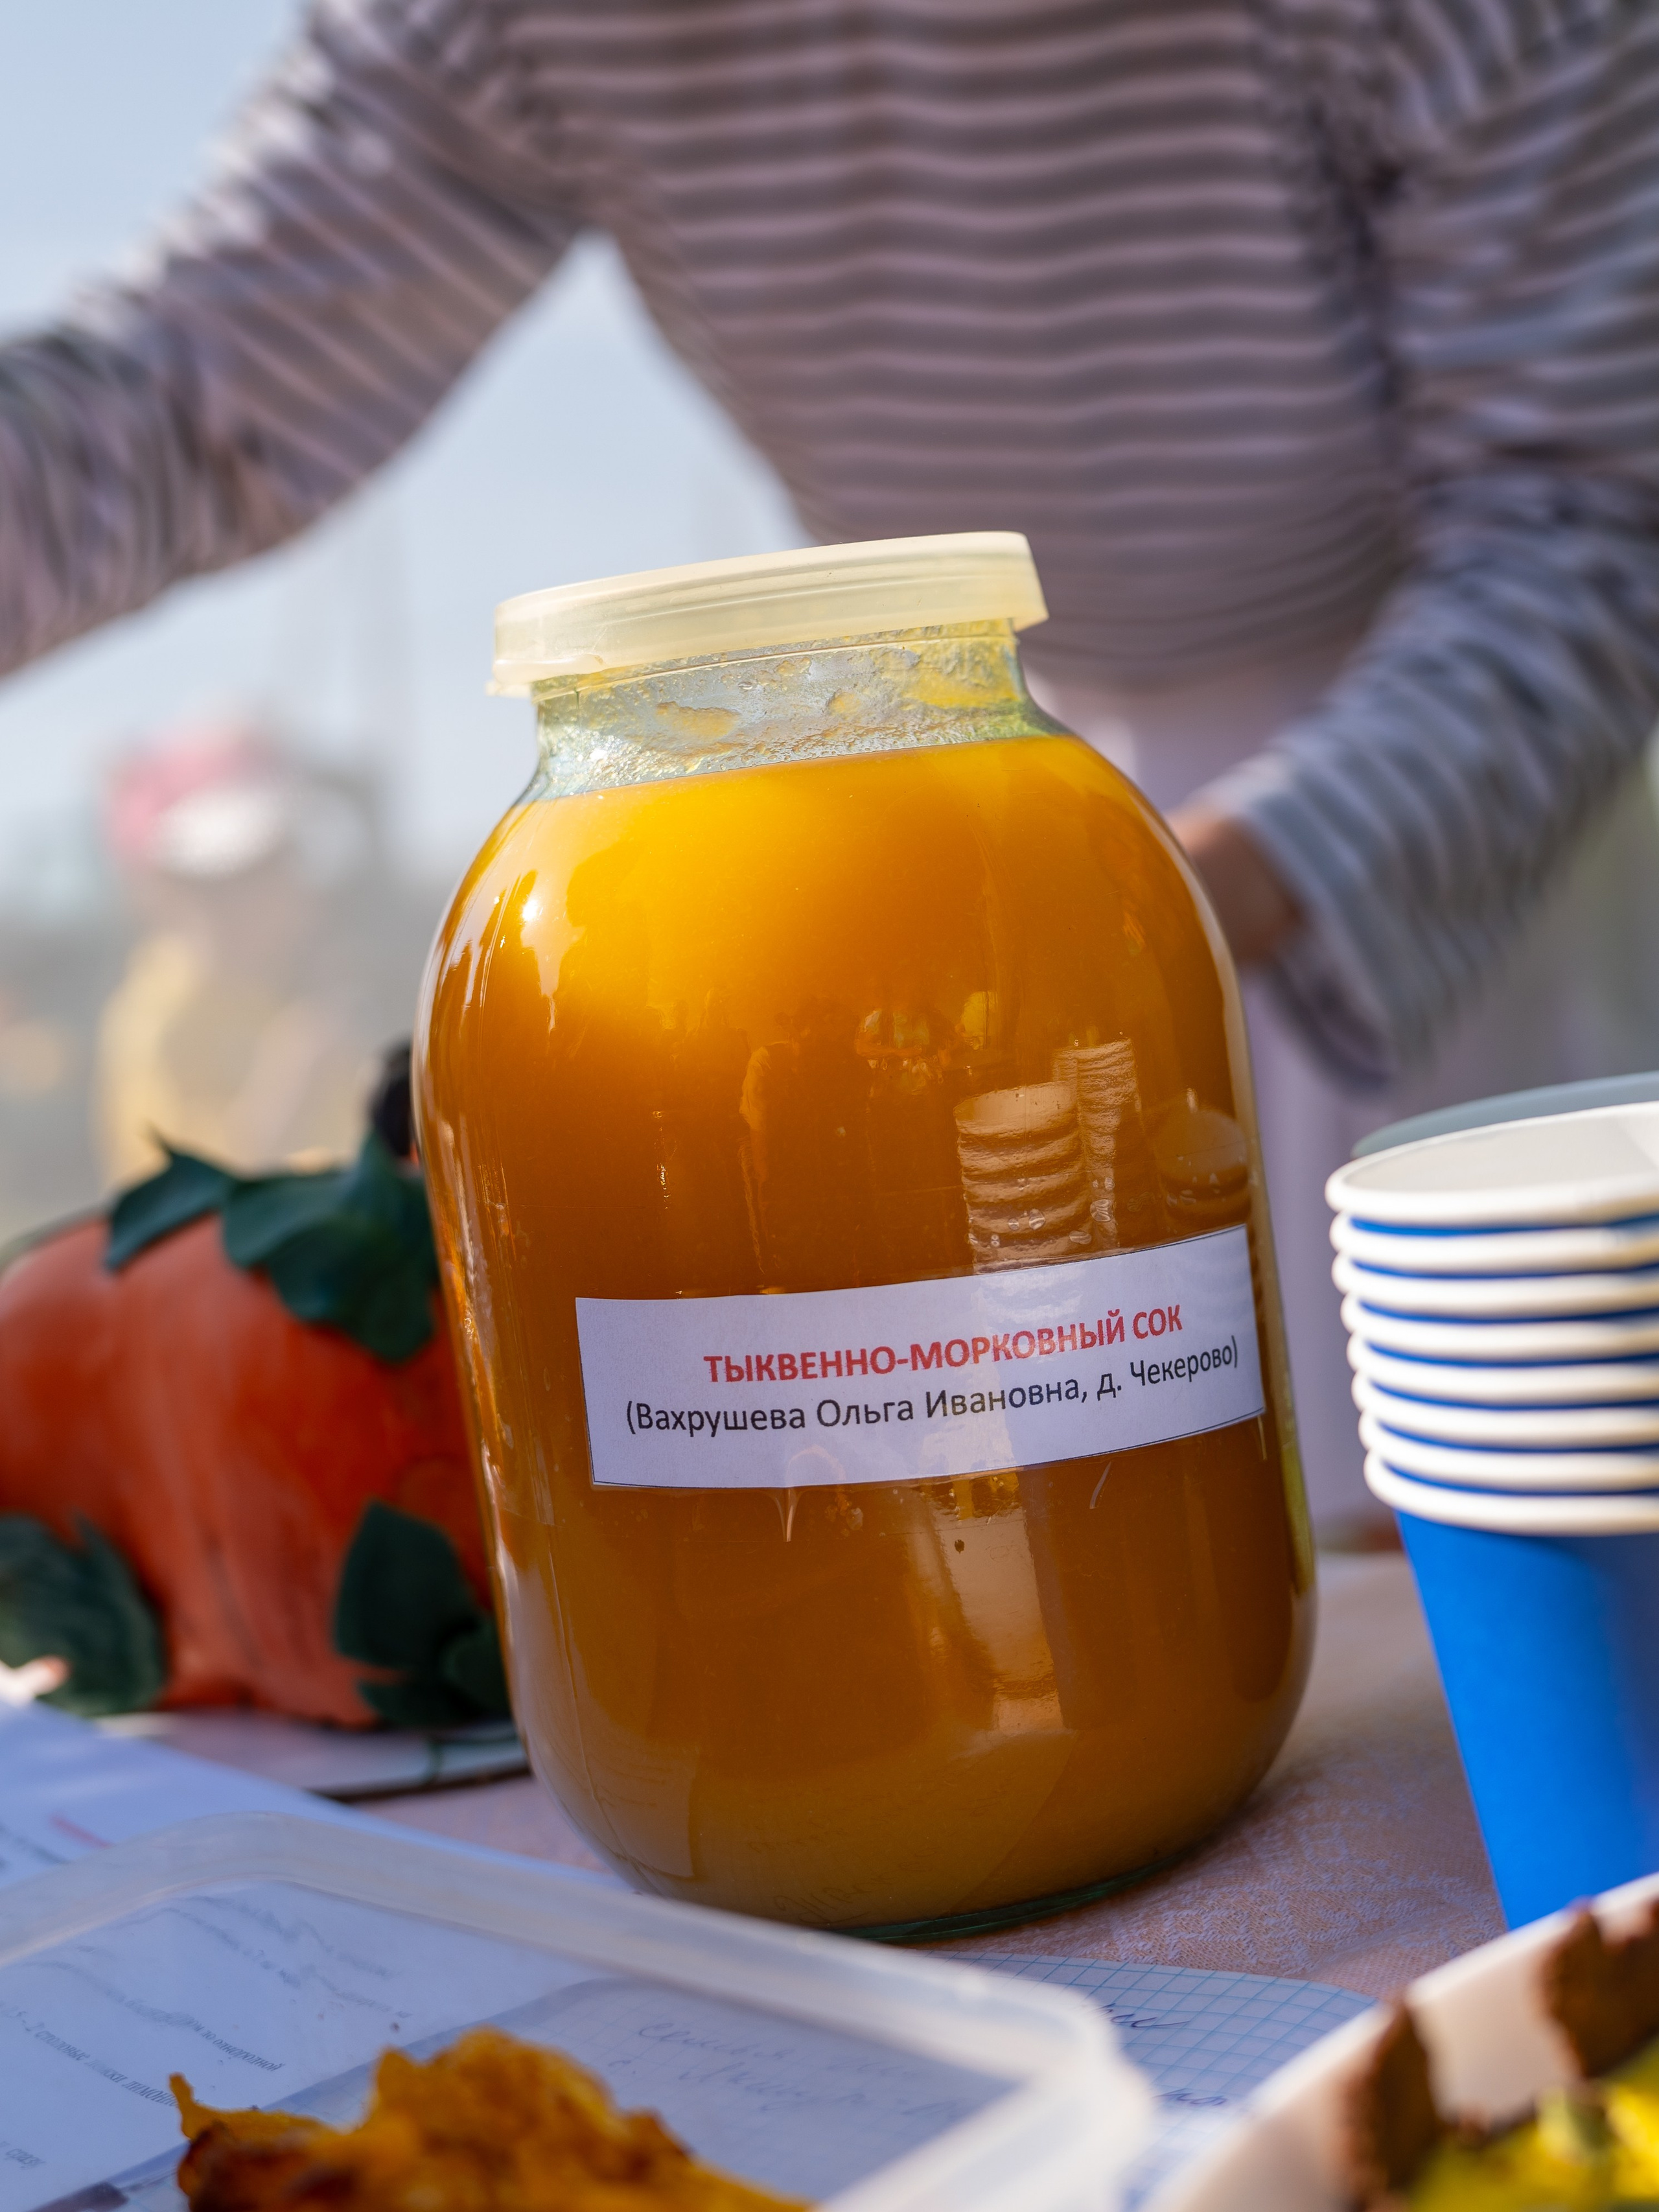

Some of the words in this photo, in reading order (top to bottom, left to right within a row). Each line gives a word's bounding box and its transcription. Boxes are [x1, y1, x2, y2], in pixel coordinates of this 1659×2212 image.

[626, 1401, 806, 1438] (Вахрушева
[817, 1399, 914, 1427] Ольга
[926, 1378, 1087, 1418] Ивановна,
[1096, 1372, 1123, 1401] д.
[1130, 1335, 1238, 1387] Чекерово)
[703, 1309, 1125, 1383] ТЫКВЕННО-МОРКОВНЫЙ
[1133, 1305, 1183, 1340] СОК
